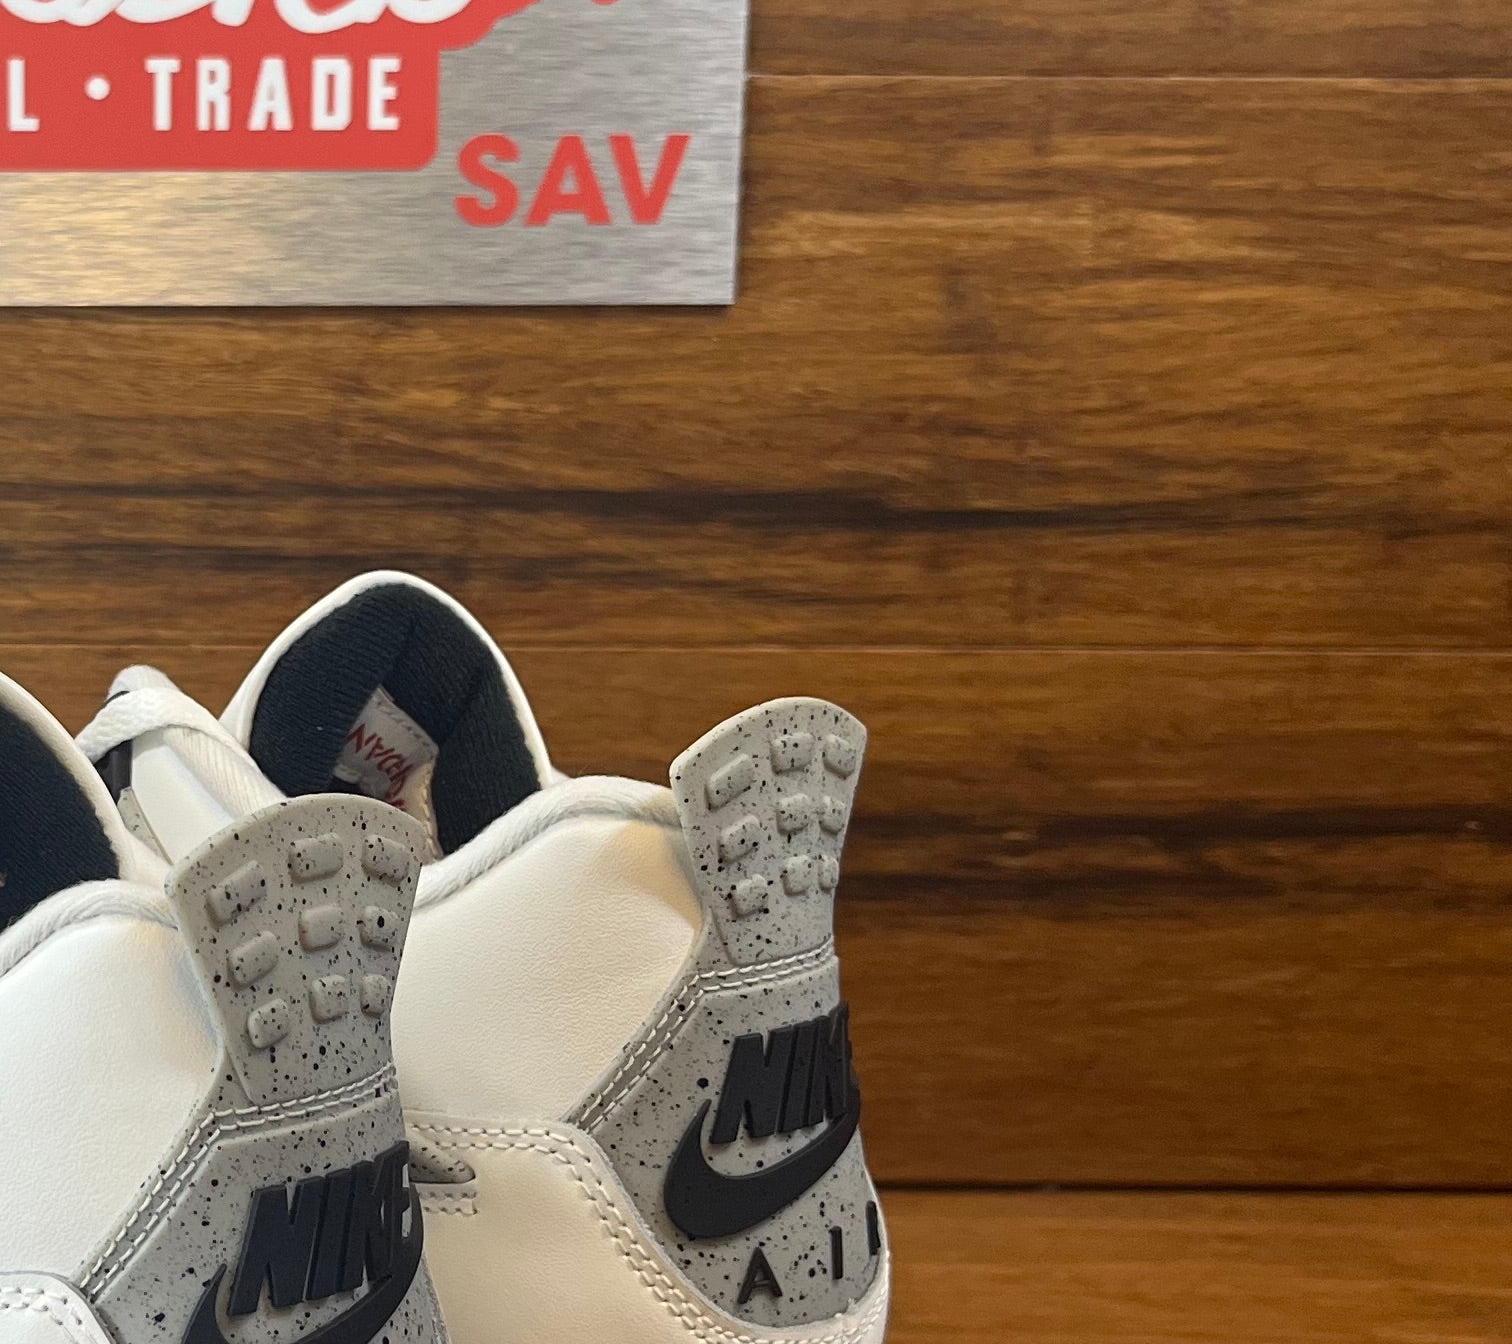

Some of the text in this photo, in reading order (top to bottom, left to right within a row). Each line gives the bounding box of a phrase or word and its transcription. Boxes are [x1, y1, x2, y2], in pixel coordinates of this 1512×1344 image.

[144, 56, 400, 131] TRADE
[454, 133, 690, 227] SAV
[709, 1001, 852, 1145] NIK
